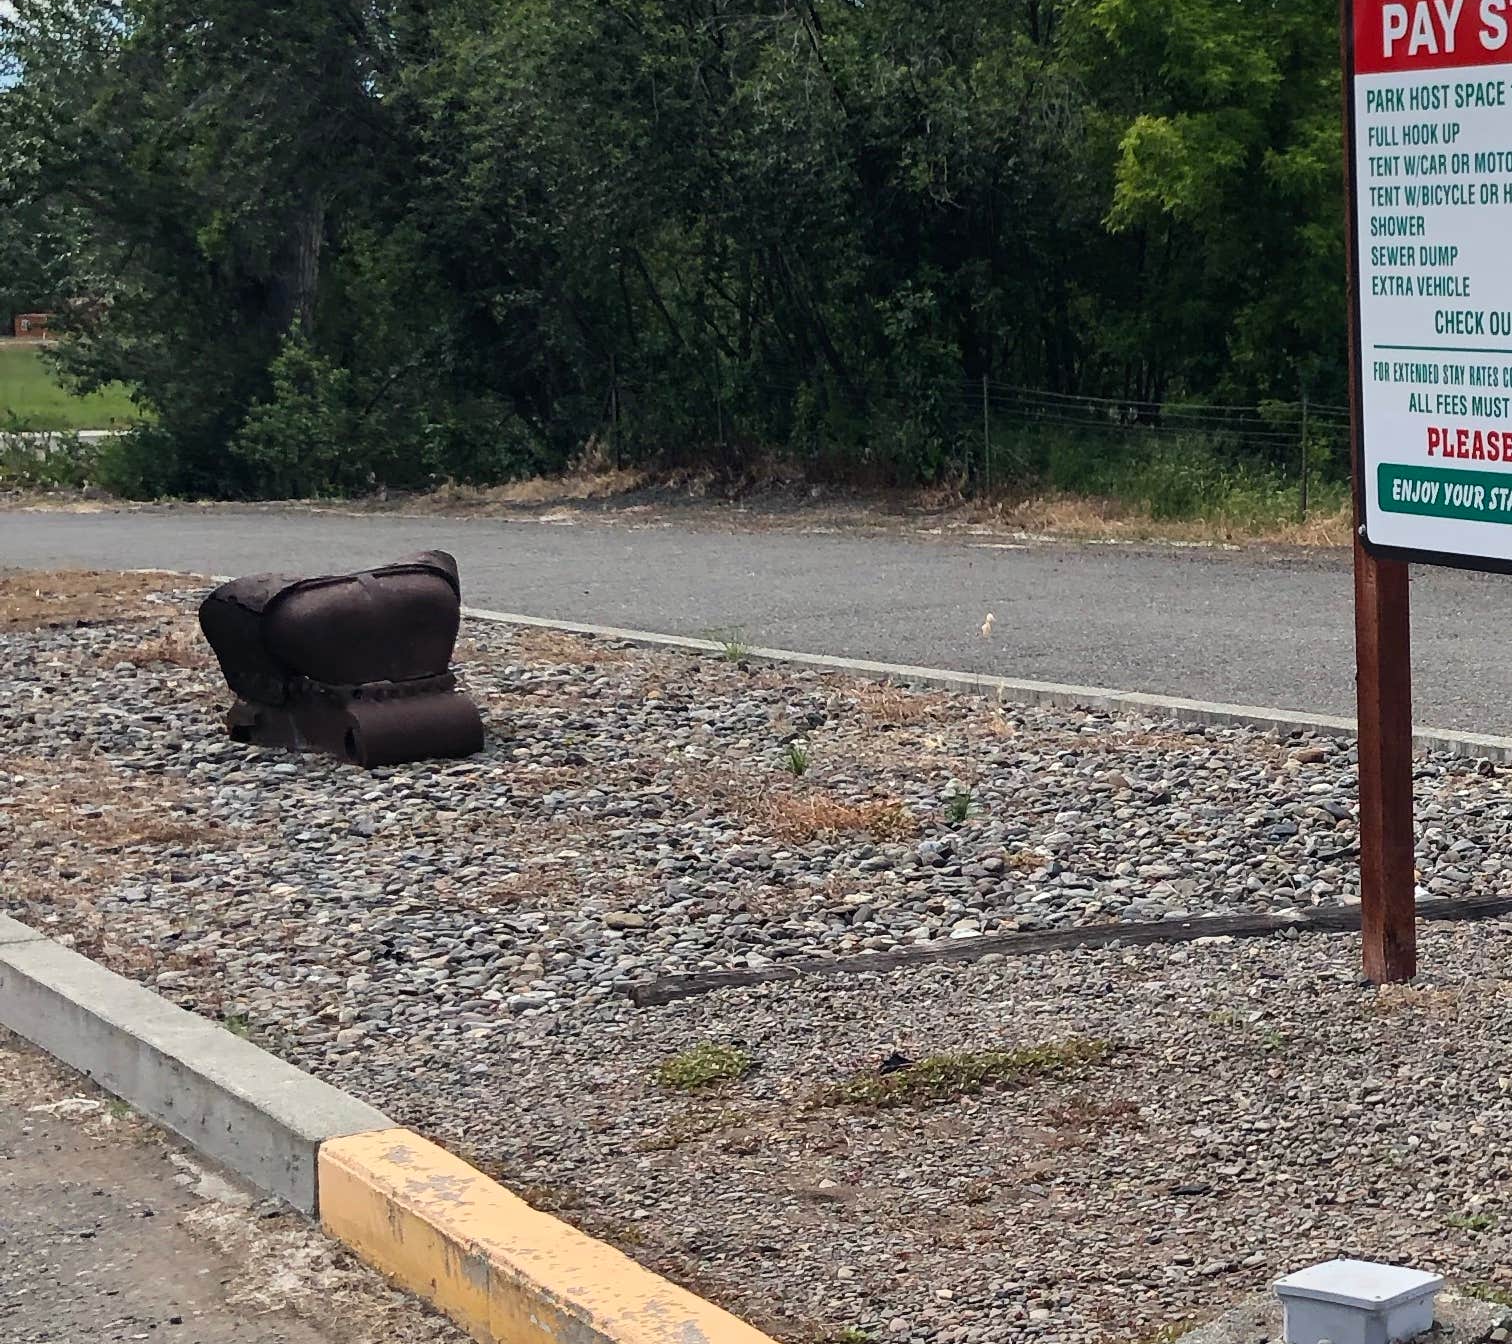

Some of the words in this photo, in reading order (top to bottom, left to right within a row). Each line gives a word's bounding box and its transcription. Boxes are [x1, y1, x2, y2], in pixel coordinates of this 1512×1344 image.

[1367, 87, 1405, 113] PARK
[1410, 85, 1450, 111] HOST
[1455, 82, 1505, 108] SPACE
[1368, 126, 1398, 147] FULL
[1402, 124, 1438, 146] HOOK
[1443, 124, 1460, 144] UP
[1369, 156, 1401, 177] TENT
[1404, 154, 1447, 176] W/CAR
[1451, 153, 1470, 173] OR
[1369, 186, 1401, 207] TENT
[1404, 184, 1475, 207] W/BICYCLE
[1480, 183, 1499, 204] OR
[1370, 216, 1425, 237] SHOWER
[1371, 247, 1416, 266] SEWER
[1420, 246, 1458, 266] DUMP
[1372, 276, 1413, 296] EXTRA
[1417, 276, 1470, 297] VEHICLE
[1435, 310, 1484, 336] CHECK
[1373, 361, 1390, 383] FOR
[1393, 362, 1439, 384] EXTENDED
[1443, 365, 1465, 386] STAY
[1469, 366, 1499, 387] RATES
[1408, 393, 1433, 414] ALL
[1437, 394, 1467, 416] FEES
[1472, 396, 1509, 418] MUST
[1392, 478, 1439, 504] ENJOY
[1443, 482, 1484, 510] YOUR
